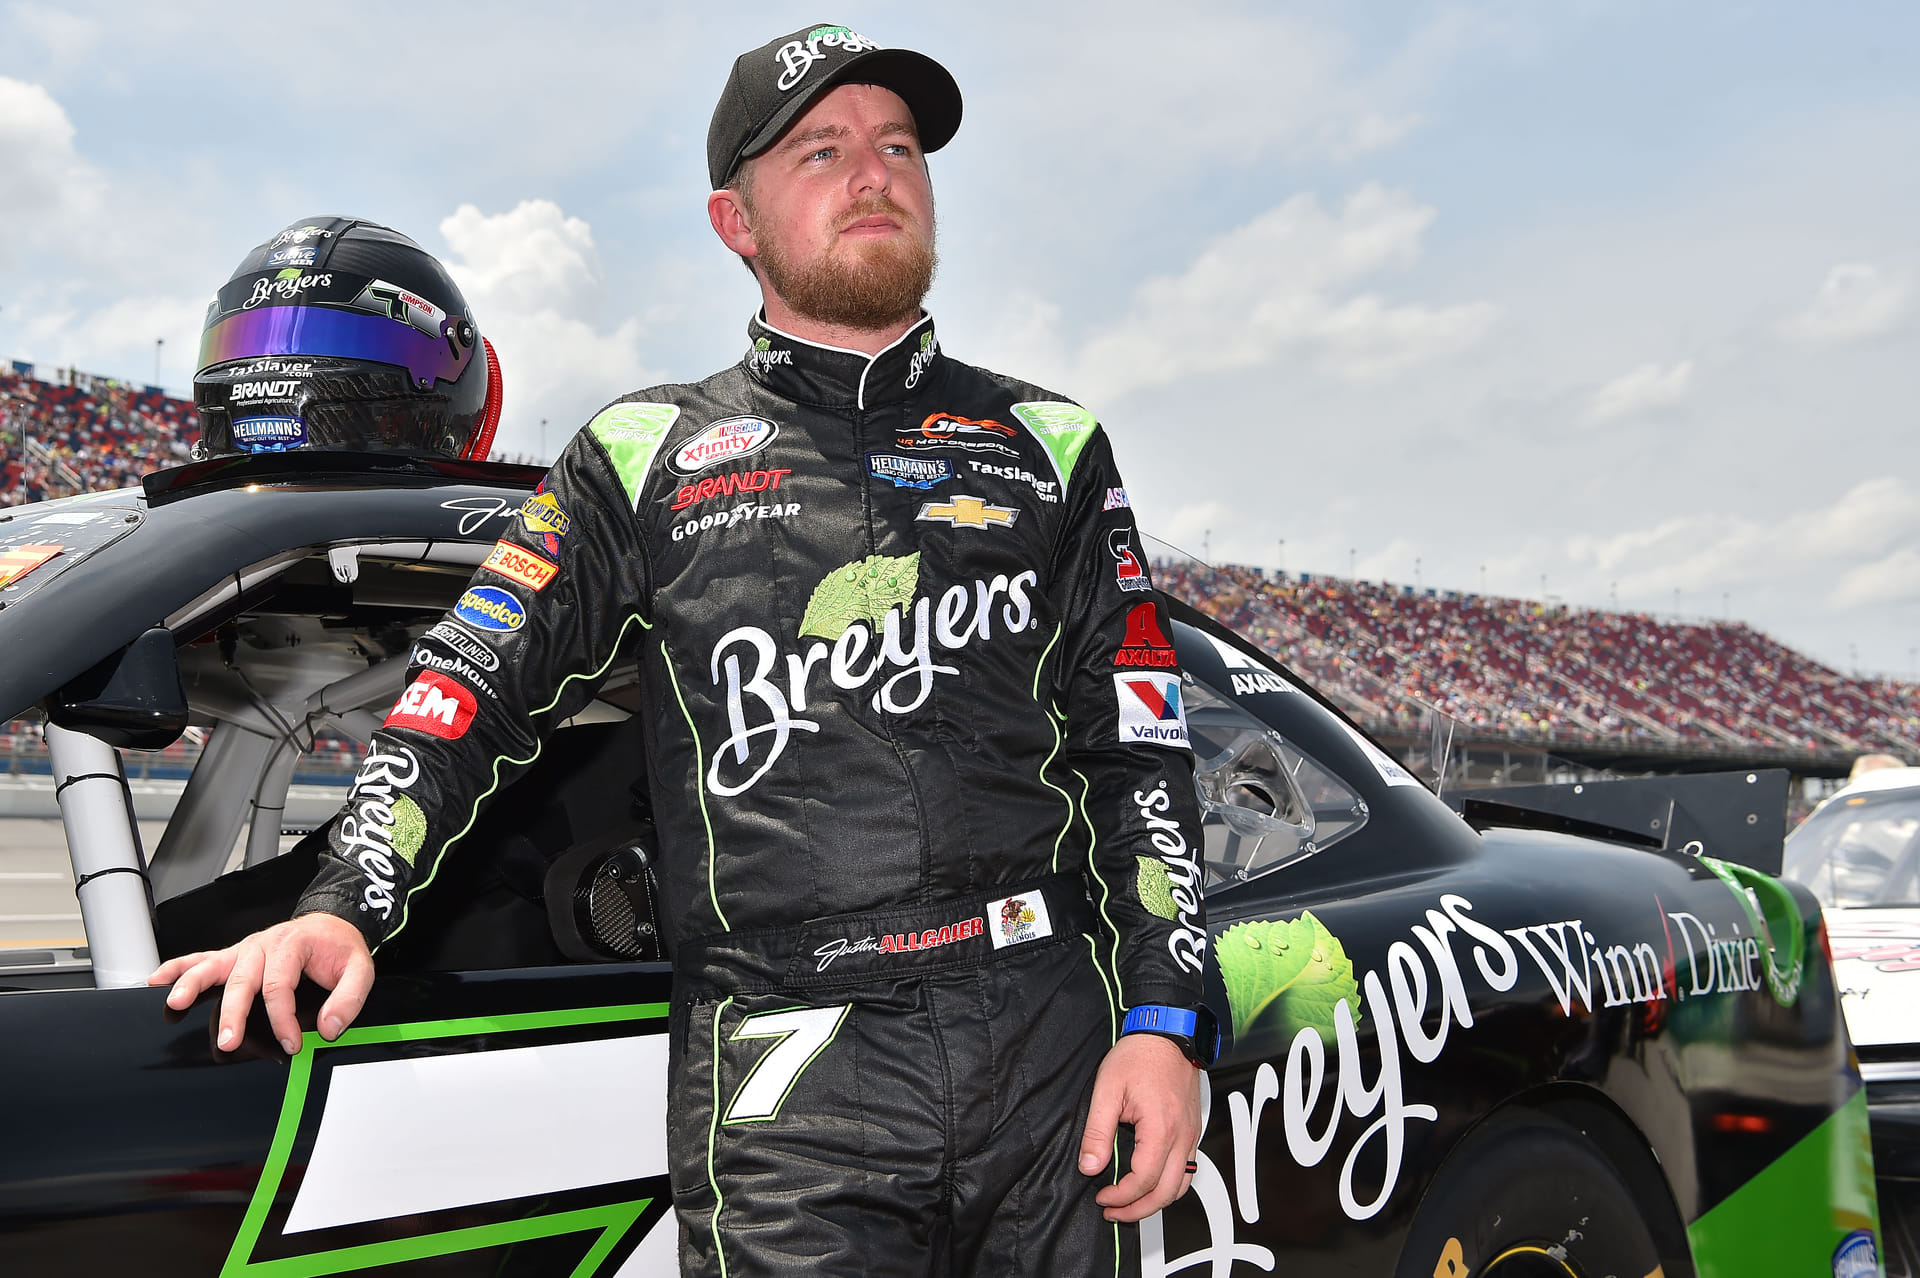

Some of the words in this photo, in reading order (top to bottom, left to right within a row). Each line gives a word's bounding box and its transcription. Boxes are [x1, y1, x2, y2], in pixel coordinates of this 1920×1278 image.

[775, 31, 880, 91] Brey
[242, 273, 333, 309] Breyers
[400, 293, 433, 314] SIMPSON
[227, 360, 312, 377] TaxSlayer
[233, 419, 302, 438] HELLMANN'S
[1040, 423, 1083, 435] SIMPSON
[683, 435, 755, 461] xfinity
[871, 457, 946, 475] HELLMANN'S
[968, 460, 1056, 493] TaxSlayer
[670, 468, 792, 511] BRANDT
[671, 501, 801, 541] GOODYEAR
[499, 552, 550, 584] BOSCH
[460, 591, 523, 628] speedco
[1113, 649, 1178, 667] AXALTA
[706, 569, 1037, 797] Breyers
[340, 739, 420, 921] Breyers
[813, 933, 883, 973] Justin
[877, 917, 985, 955] ALLGAIER
[1005, 931, 1037, 945] ILLINOIS
[1503, 918, 1668, 1018] Winn
[1667, 911, 1762, 997] Dixie
[722, 1003, 853, 1126] 7
